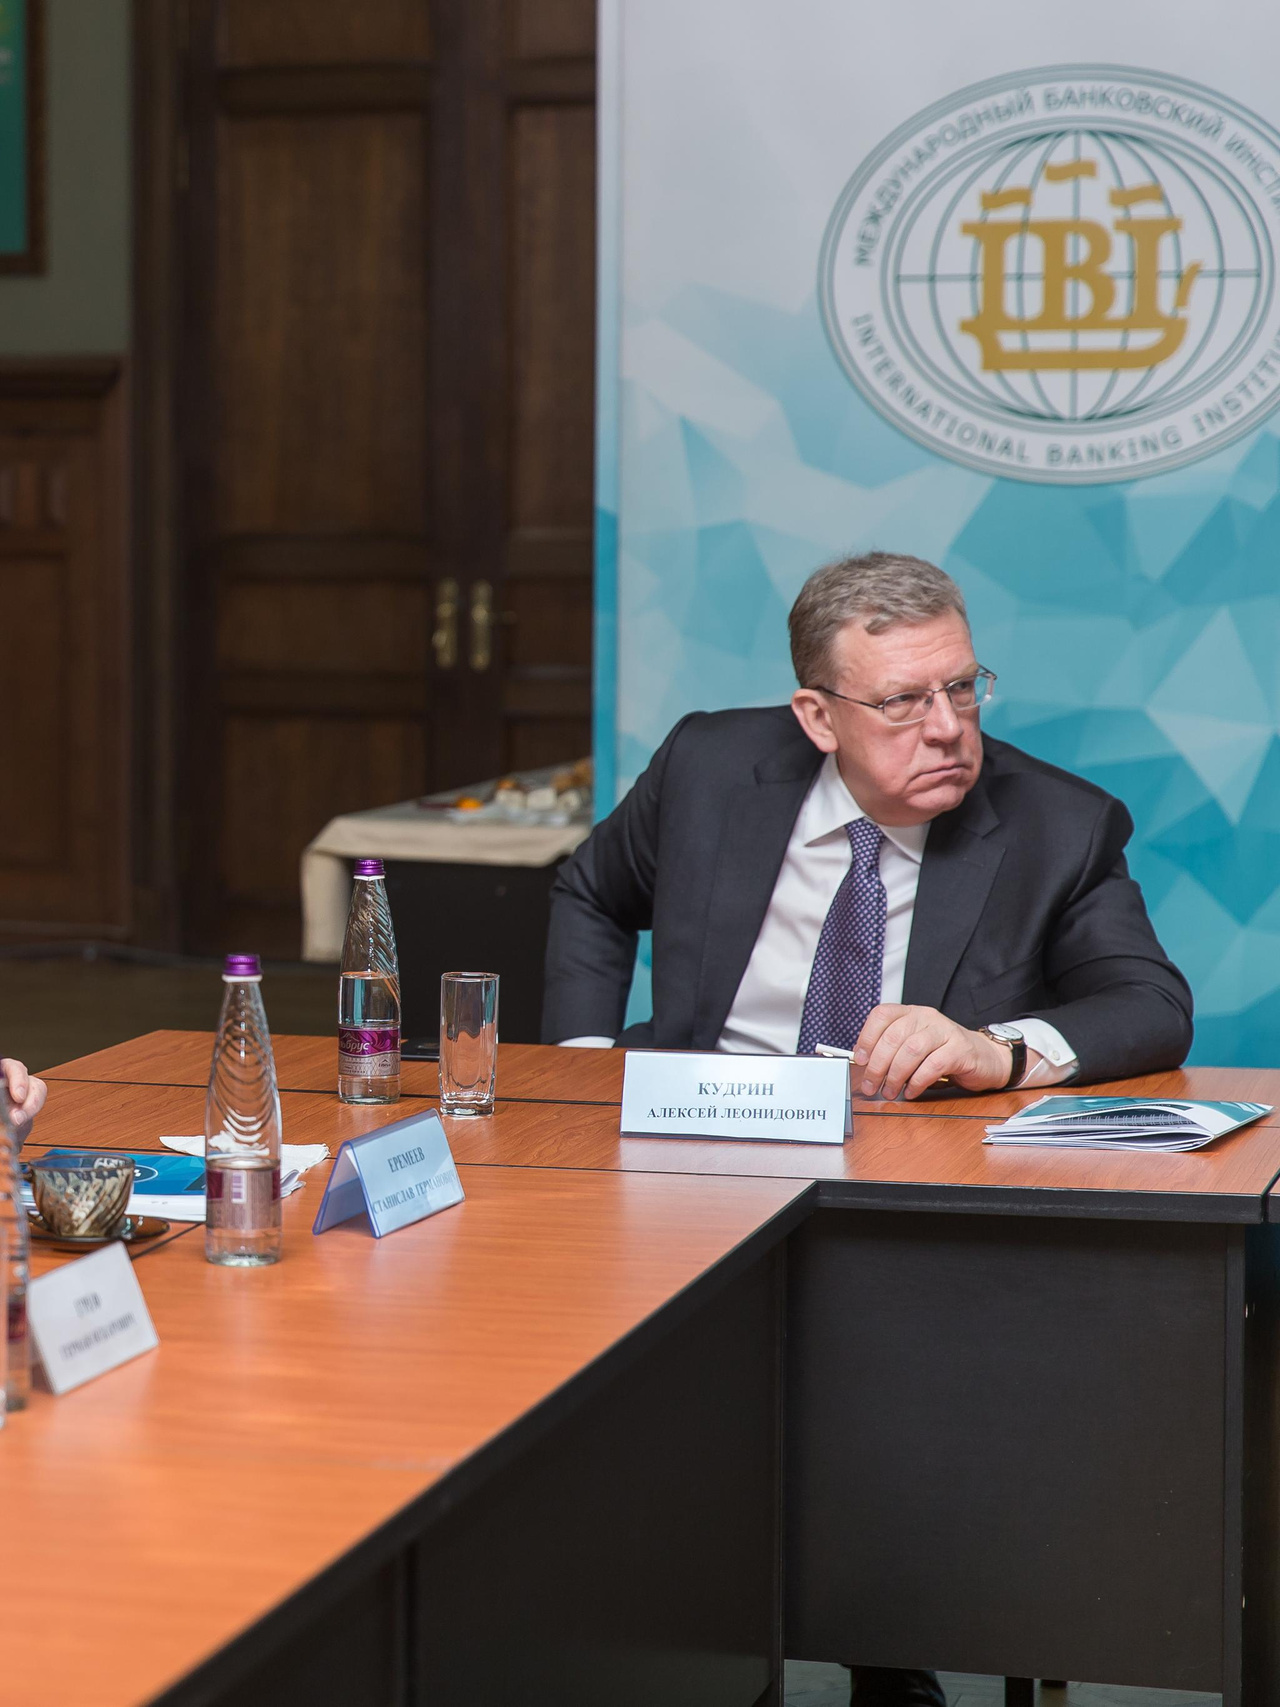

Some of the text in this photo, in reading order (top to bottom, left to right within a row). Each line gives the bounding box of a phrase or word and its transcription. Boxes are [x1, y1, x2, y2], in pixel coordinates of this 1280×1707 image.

[854, 86, 1035, 267] МЕЖДУНАРОДНЫЙ
[1043, 86, 1226, 143] БАНКОВСКИЙ
[851, 312, 1030, 463] INTERNATIONAL
[1045, 424, 1183, 468] BANKING
[697, 1082, 775, 1096] КУДРИН
[646, 1106, 827, 1121] АЛЕКСЕЙ ЛЕОНИДОВИЧ
[387, 1146, 426, 1173] ЕРЕМЕЕВ
[372, 1186, 415, 1214] СТАНИСЛАВ
